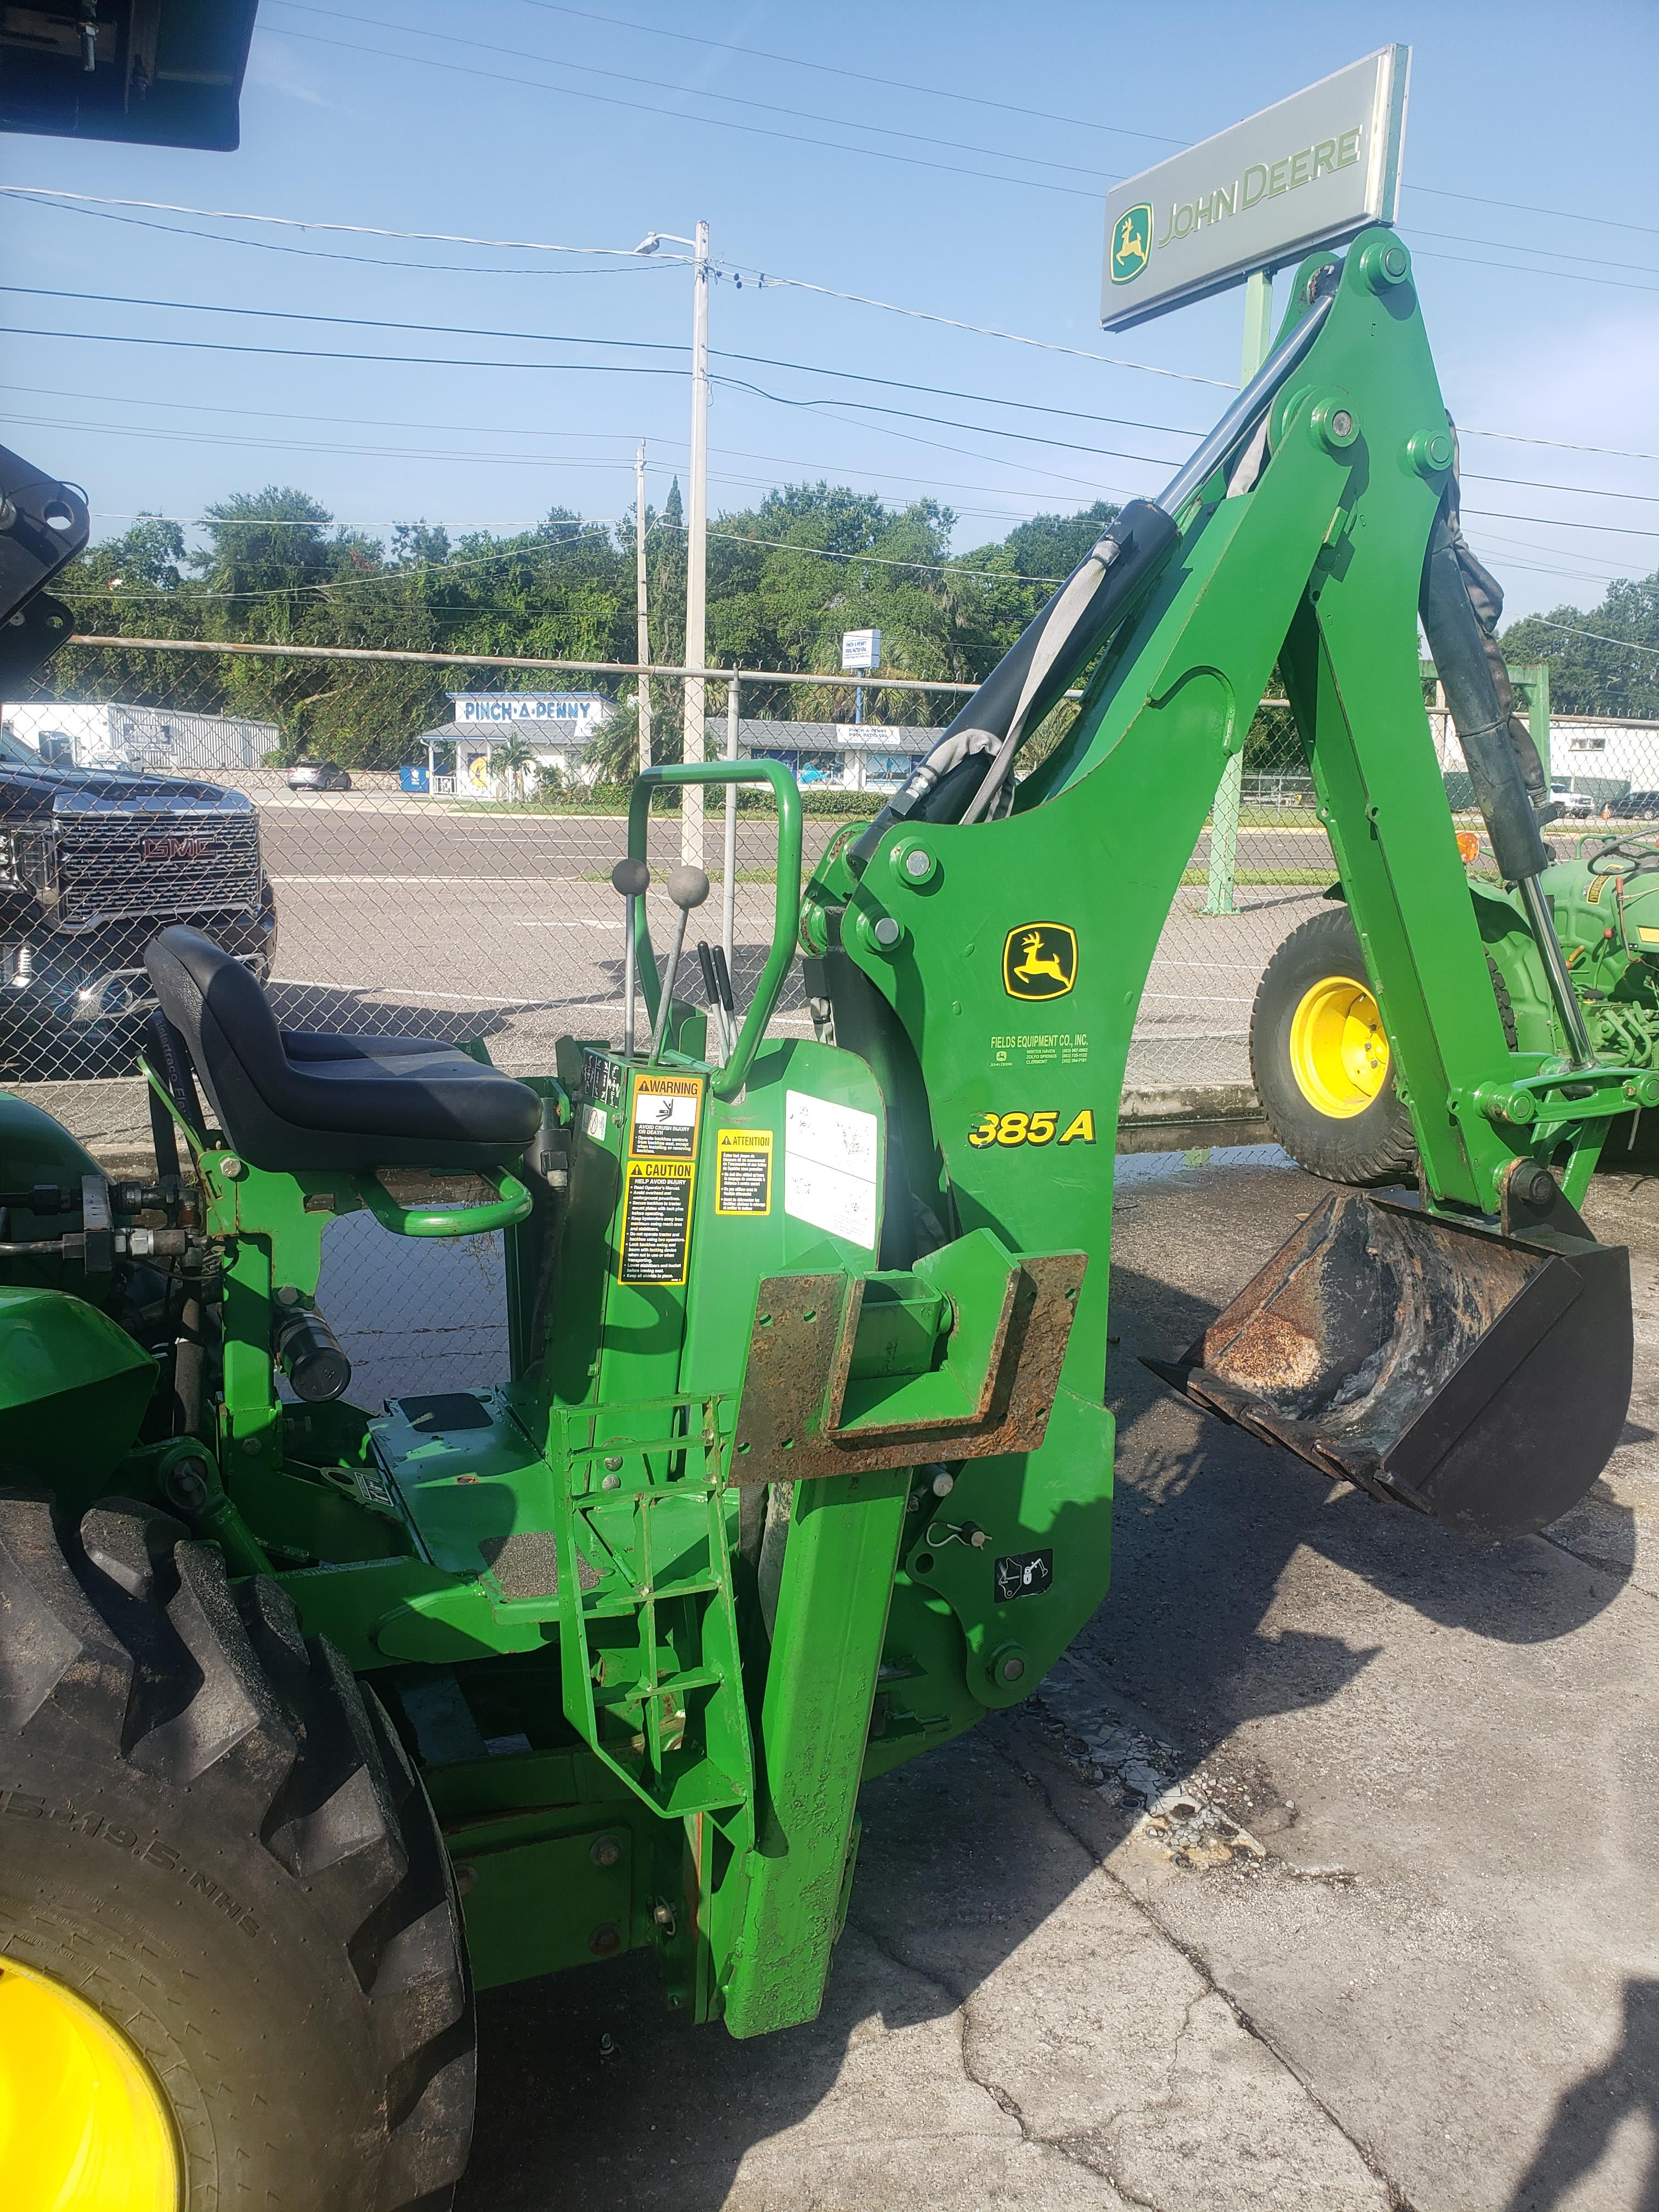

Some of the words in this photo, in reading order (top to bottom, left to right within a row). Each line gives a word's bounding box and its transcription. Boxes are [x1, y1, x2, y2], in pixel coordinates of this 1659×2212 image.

[1158, 180, 1239, 247] JOHN
[1241, 124, 1363, 210] DEERE
[144, 838, 215, 857] GMC
[991, 1036, 1015, 1048] FIELDS
[1017, 1035, 1058, 1048] EQUIPMENT
[1059, 1035, 1073, 1048] CO.,
[1075, 1034, 1088, 1046] INC.
[650, 1080, 698, 1095] WARNING
[967, 1110, 1059, 1148] 385
[1057, 1109, 1097, 1146] A
[733, 1136, 770, 1146] ATTENTION
[646, 1164, 691, 1176] CAUTION
[187, 1871, 259, 1938] NHS
